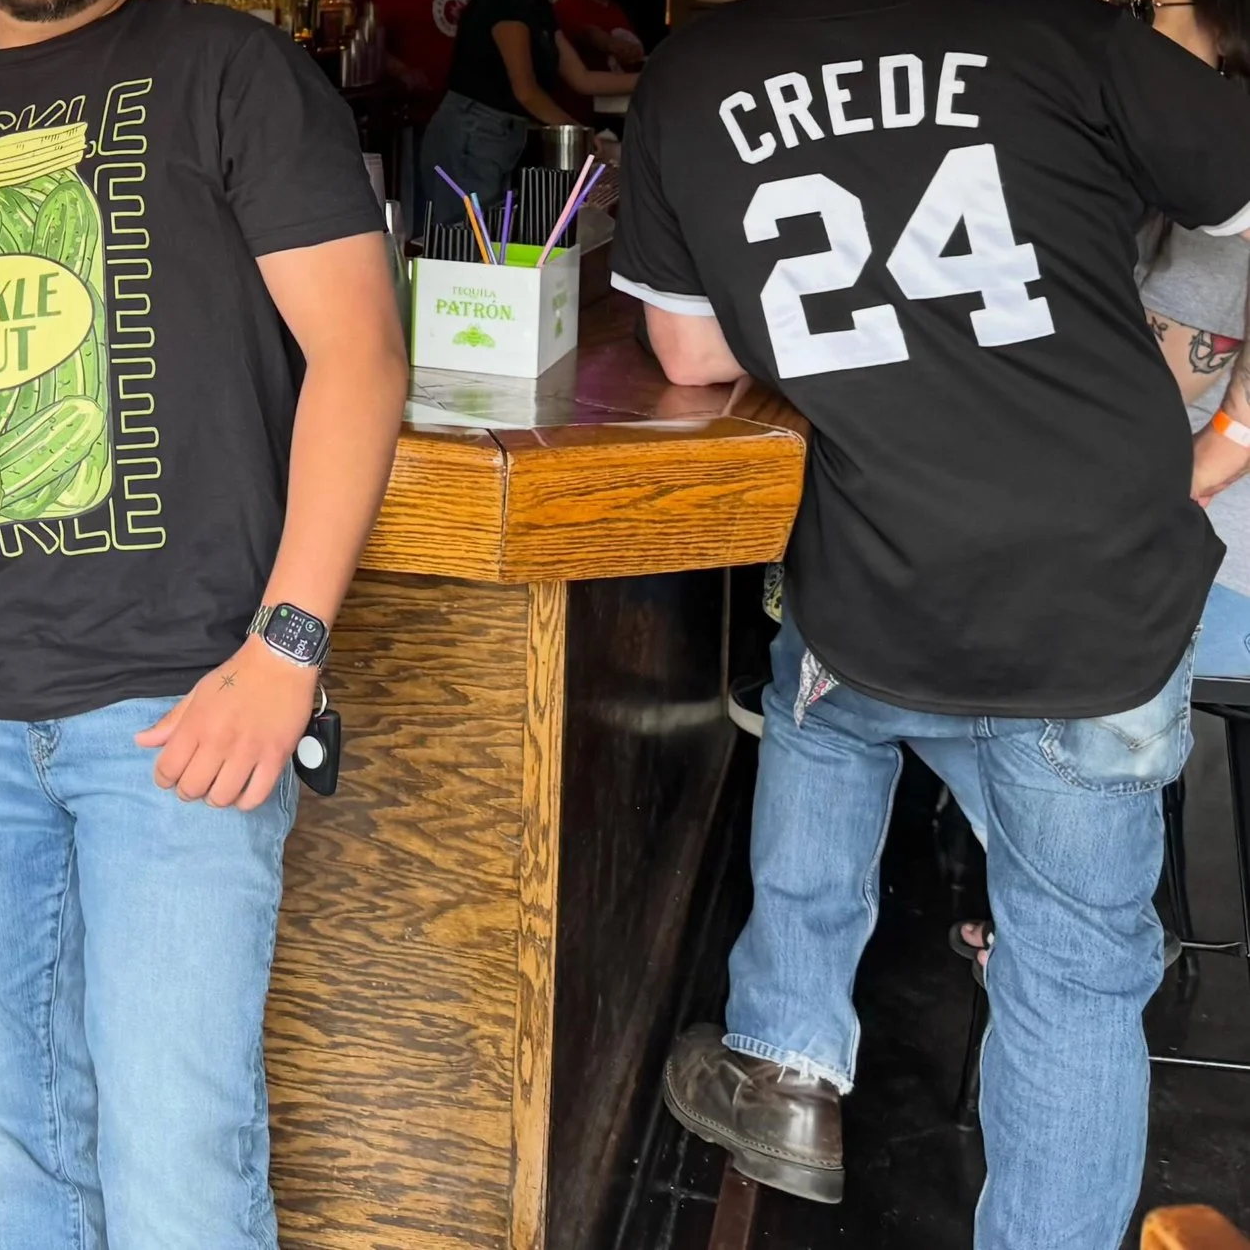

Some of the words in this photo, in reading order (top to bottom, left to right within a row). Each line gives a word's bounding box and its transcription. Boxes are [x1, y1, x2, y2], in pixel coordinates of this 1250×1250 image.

[719, 52, 988, 164] CREDE
[452, 286, 497, 298] TEQUILA
[742, 143, 1056, 379] 24
[435, 298, 512, 321] PATRÓN
